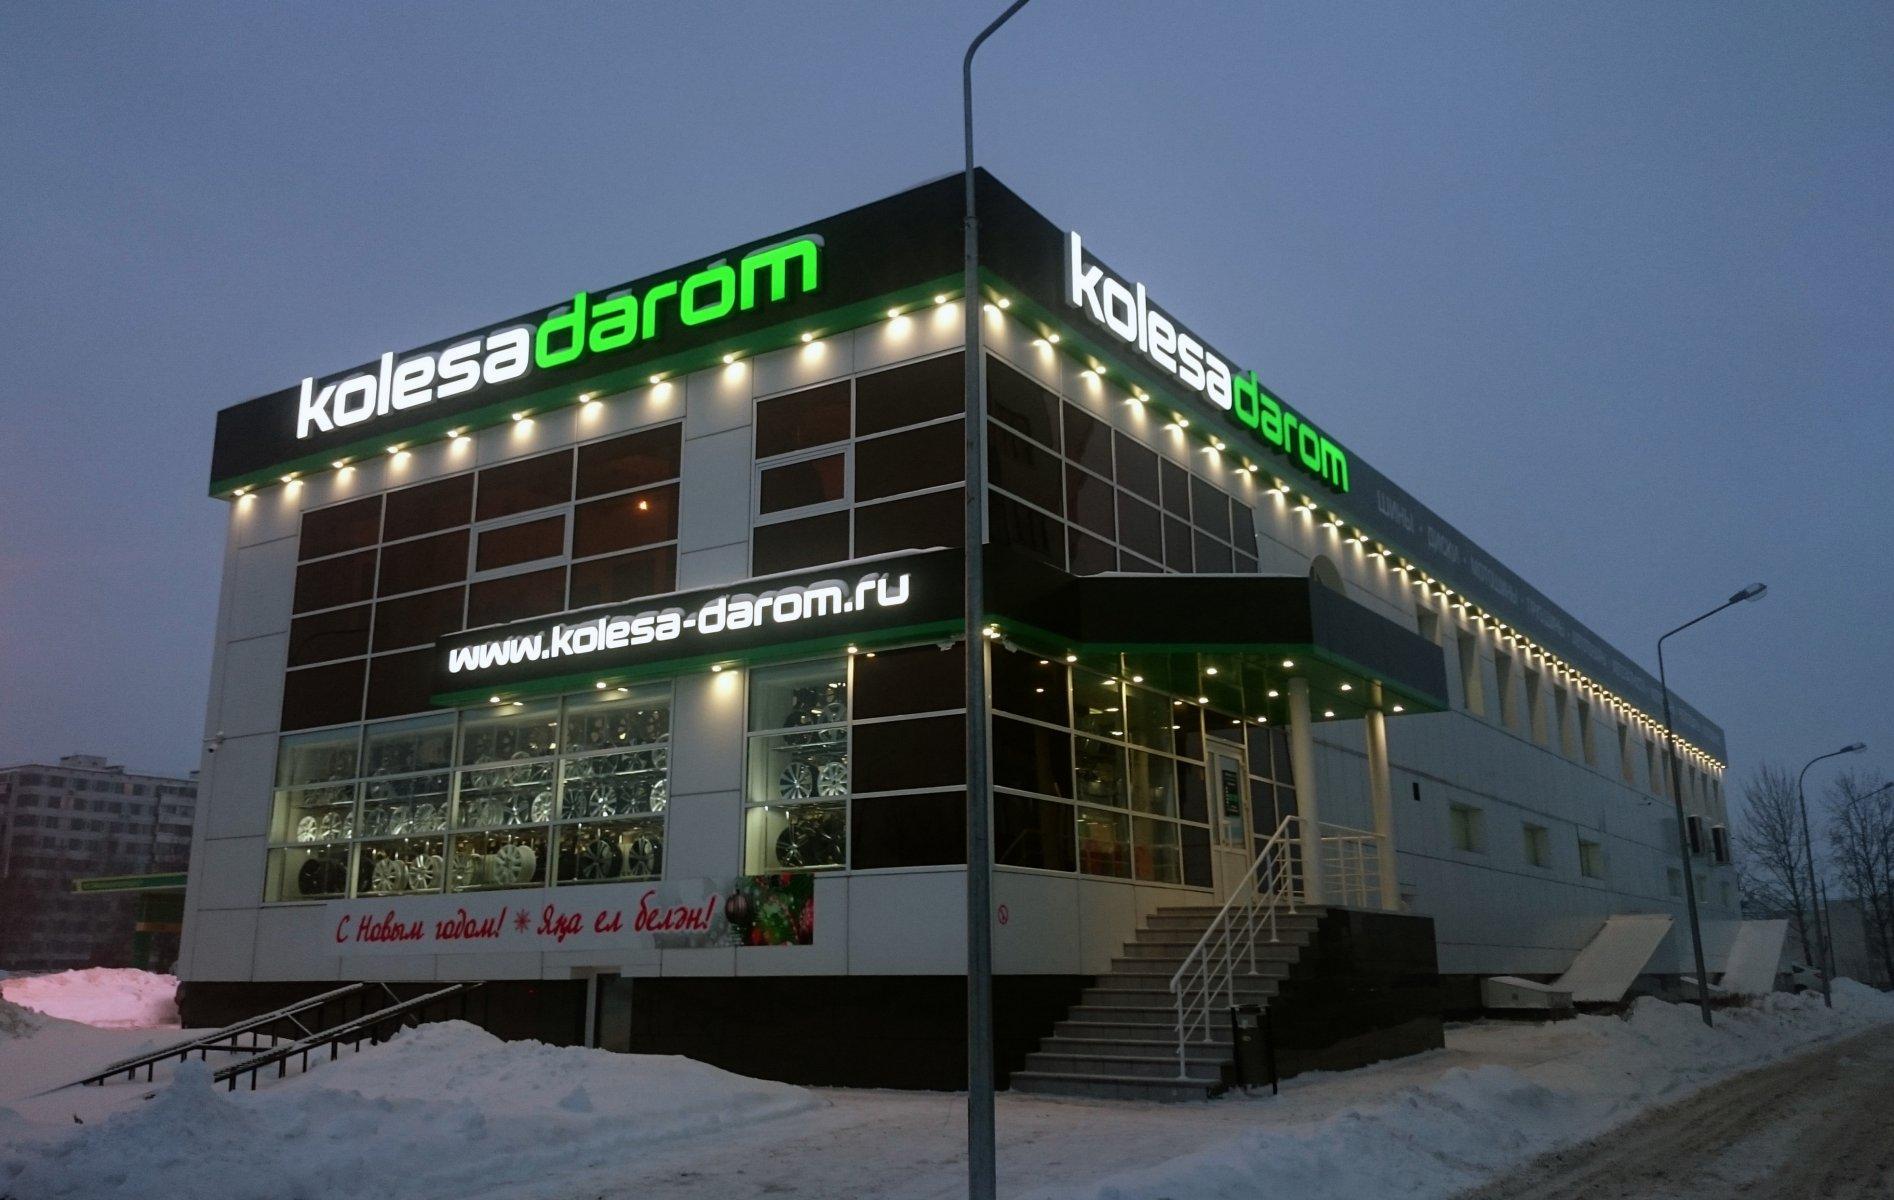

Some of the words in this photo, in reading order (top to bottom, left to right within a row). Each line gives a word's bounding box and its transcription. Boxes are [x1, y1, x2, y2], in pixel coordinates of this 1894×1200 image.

[448, 573, 910, 674] www.kolesa-darom.ru
[336, 914, 351, 943] С
[356, 910, 425, 942] Новым
[435, 906, 507, 940] годом!
[594, 910, 624, 933] ел
[633, 889, 717, 933] белән!
